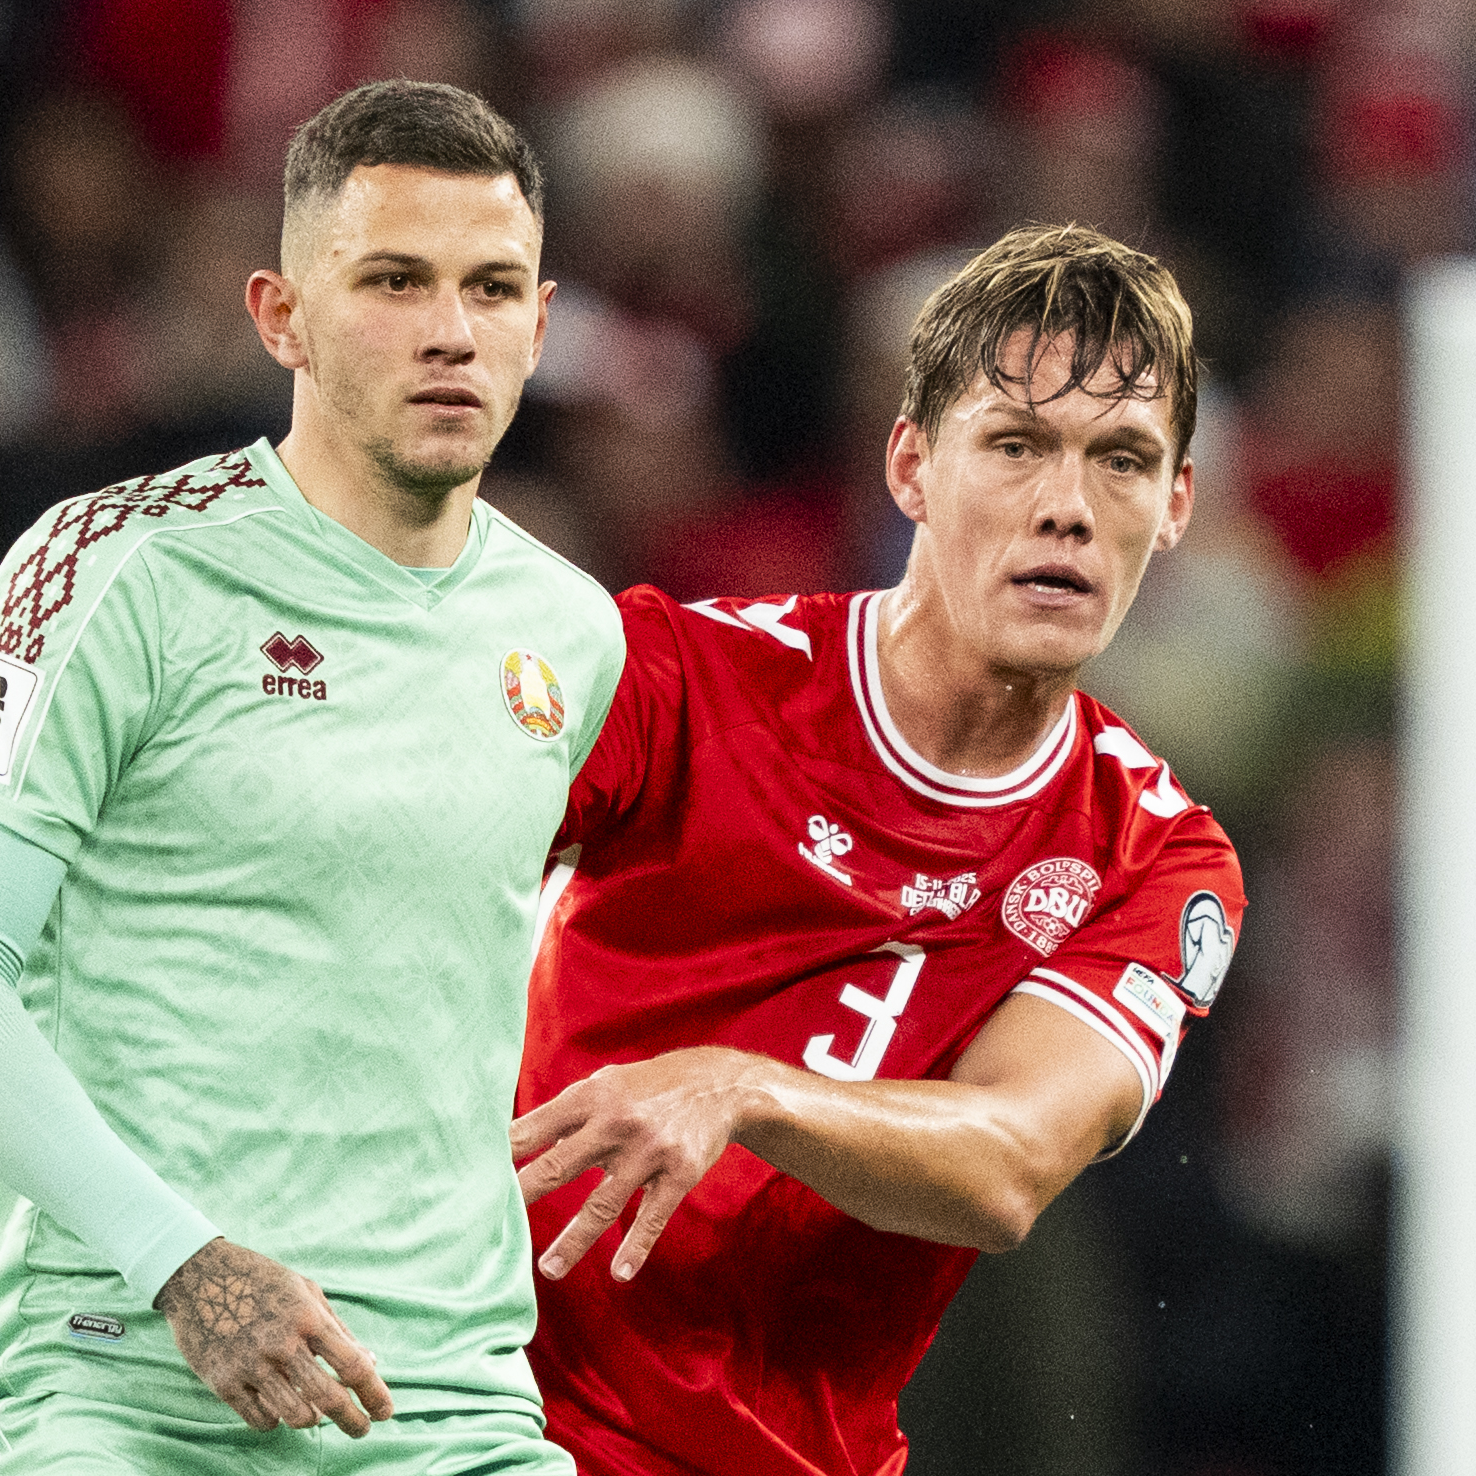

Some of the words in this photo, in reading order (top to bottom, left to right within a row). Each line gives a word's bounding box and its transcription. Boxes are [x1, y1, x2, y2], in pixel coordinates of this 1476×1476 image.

[262, 673, 327, 701] errea
[1006, 881, 1028, 932] DANSK
[1024, 887, 1088, 928] DBU
[1132, 966, 1155, 985] UEFA
[802, 941, 926, 1082] 3
